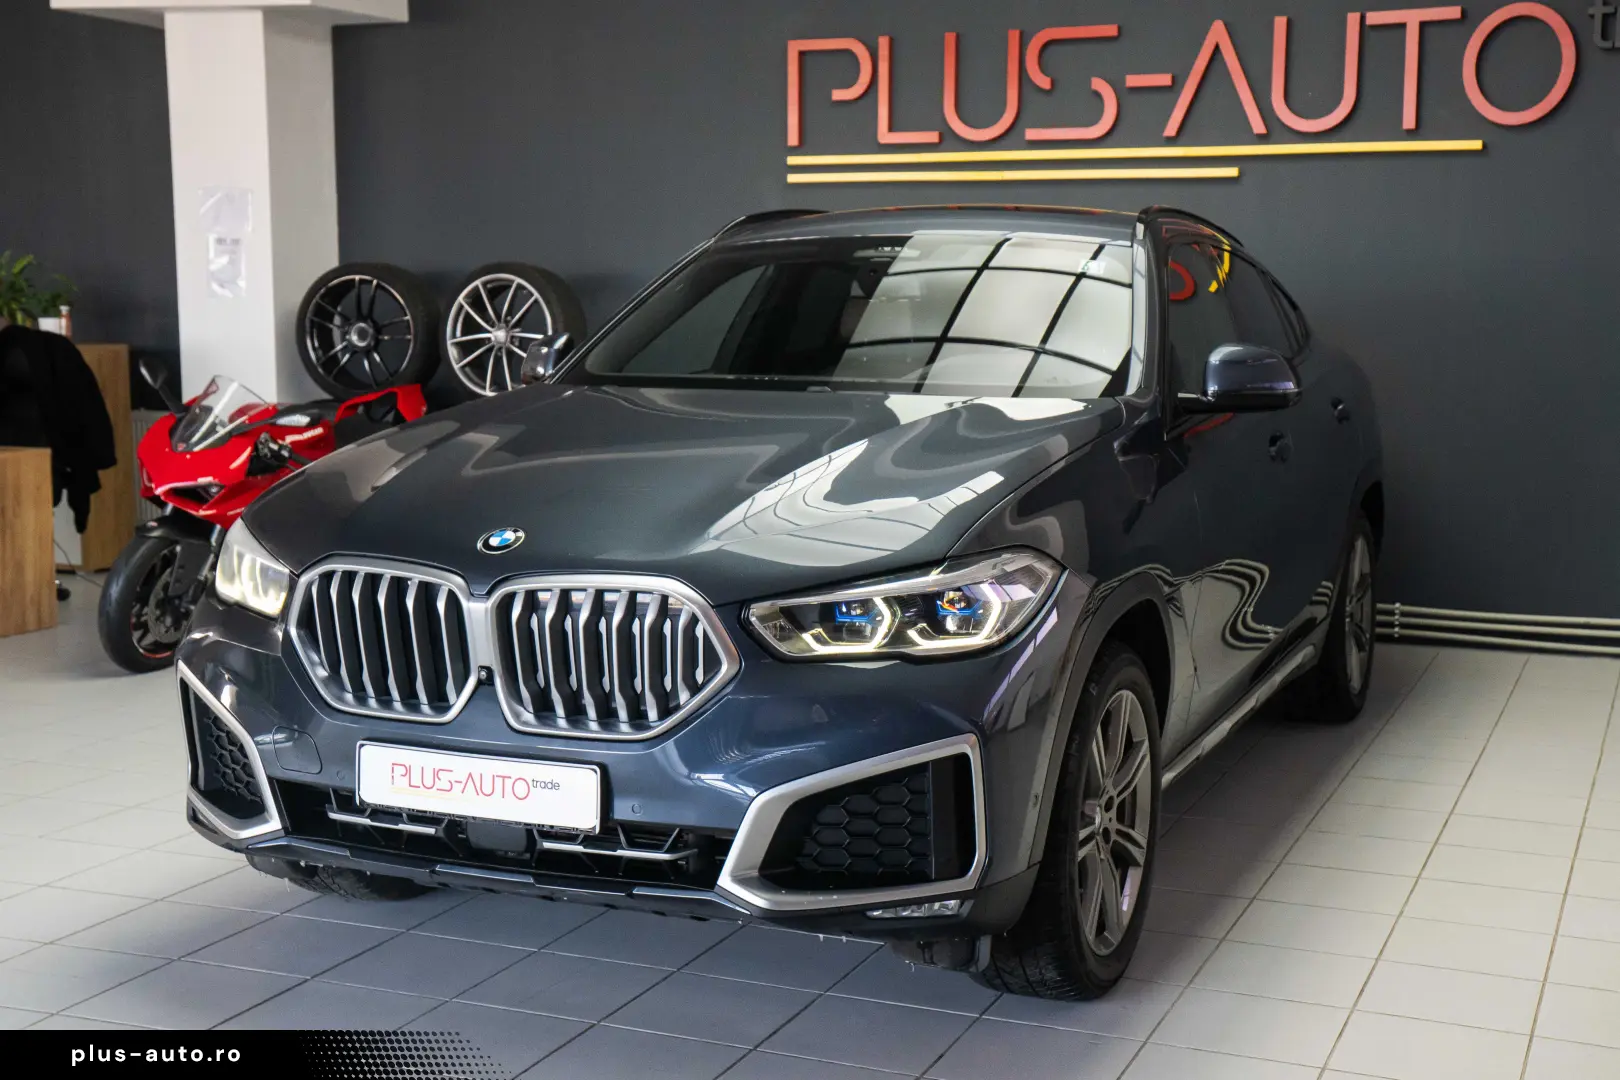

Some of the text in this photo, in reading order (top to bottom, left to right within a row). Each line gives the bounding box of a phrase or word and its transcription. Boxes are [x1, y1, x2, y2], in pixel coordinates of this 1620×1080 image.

[786, 1, 1577, 146] PLUS-AUTO
[391, 763, 560, 800] PLUS-AUTO trade
